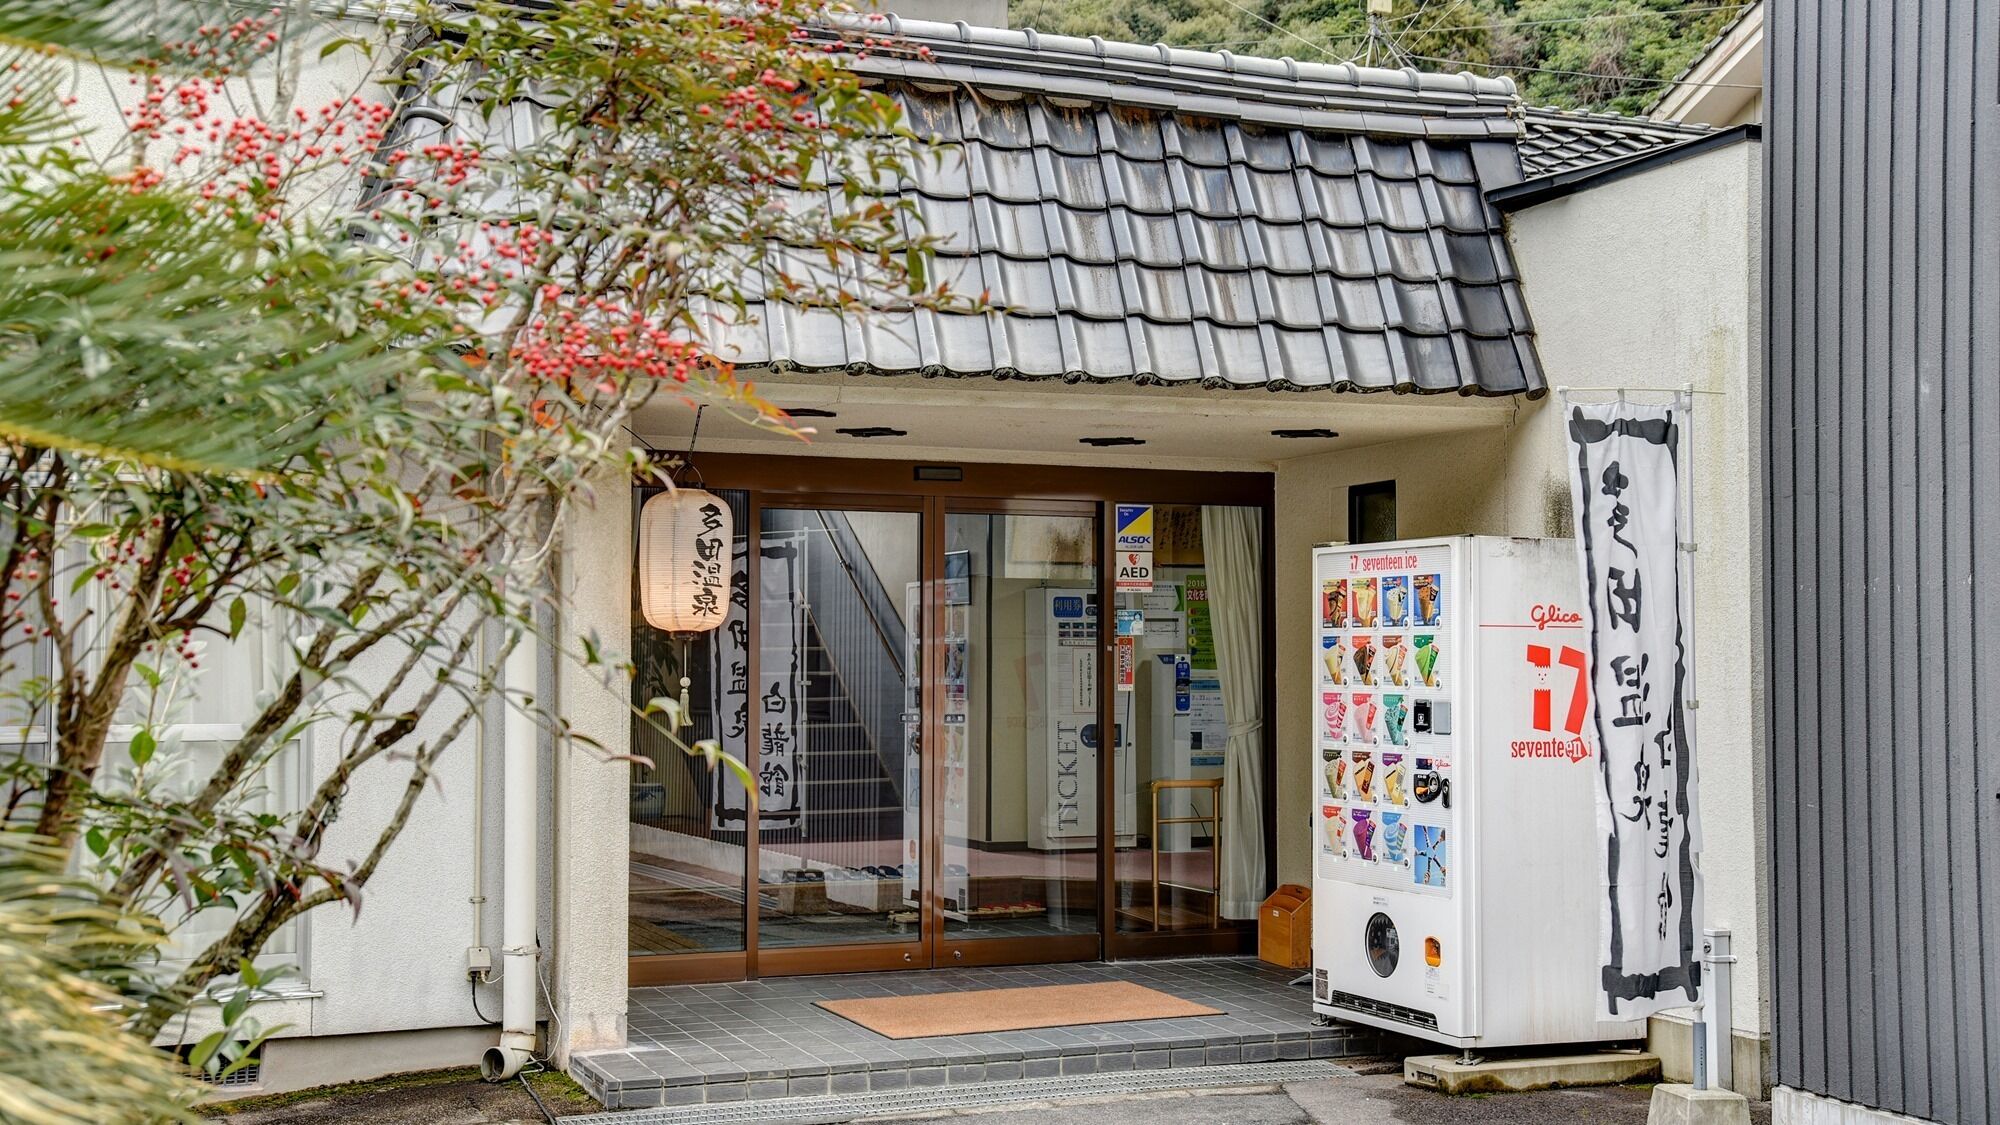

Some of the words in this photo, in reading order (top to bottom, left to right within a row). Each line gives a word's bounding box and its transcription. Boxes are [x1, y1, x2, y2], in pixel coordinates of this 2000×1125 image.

[1118, 535, 1151, 544] ALSOK
[691, 502, 724, 617] 多田温泉
[1362, 554, 1403, 571] seventeen
[1405, 550, 1418, 569] ice
[1119, 566, 1149, 578] AED
[1530, 604, 1583, 631] Glico
[1511, 737, 1583, 759] seventeen
[1057, 720, 1078, 831] TICKET
